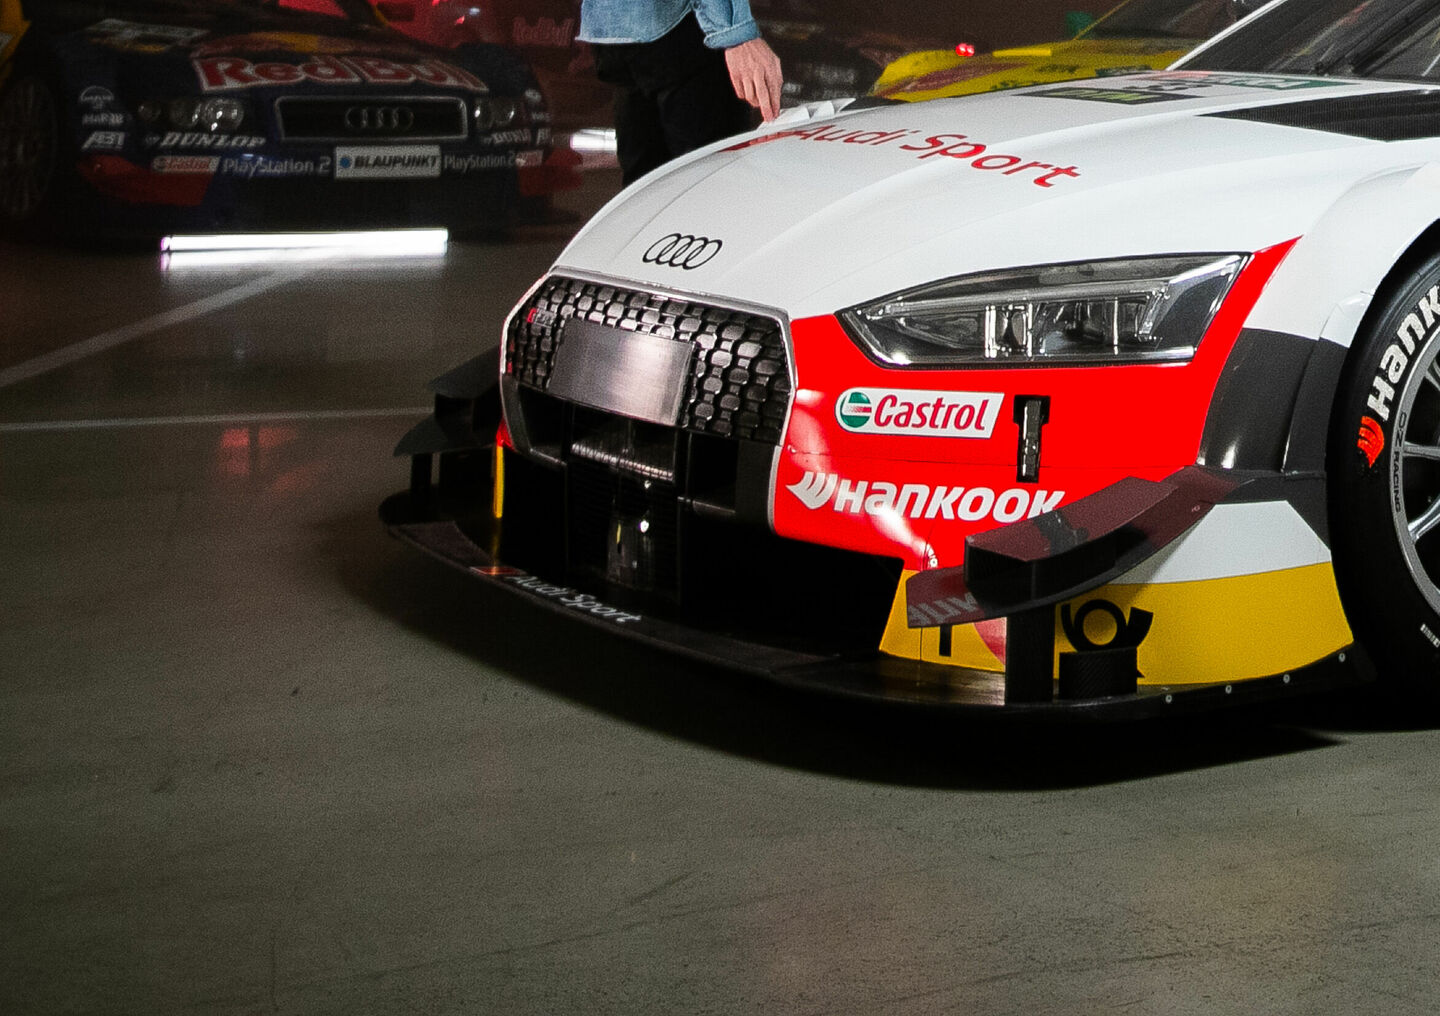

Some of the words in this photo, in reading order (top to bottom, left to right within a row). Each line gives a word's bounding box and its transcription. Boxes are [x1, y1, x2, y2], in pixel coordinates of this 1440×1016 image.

[159, 131, 267, 148] DUNLOP
[222, 157, 313, 179] PlayStation
[317, 156, 332, 173] 2
[354, 154, 439, 170] BLAUPUNKT
[793, 125, 920, 146] Audi
[900, 134, 1081, 188] Sport
[873, 394, 989, 431] Castrol
